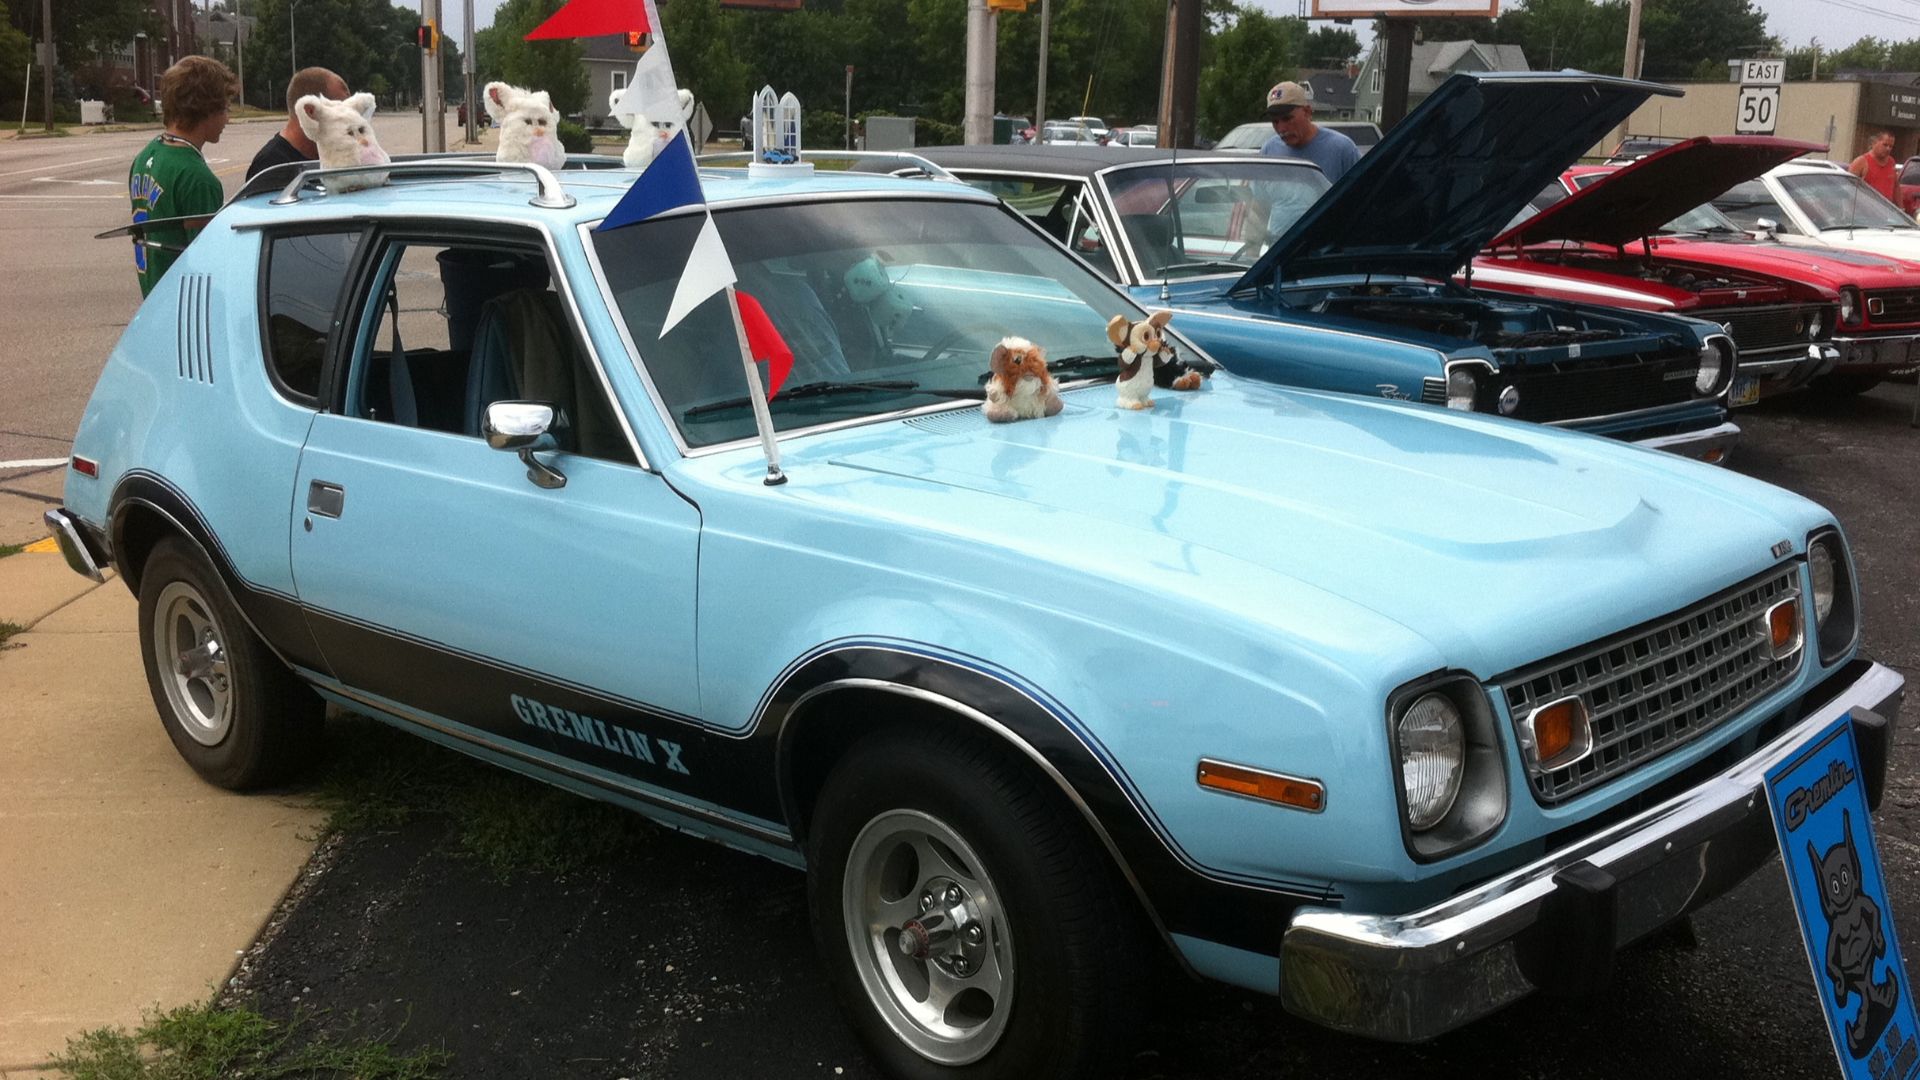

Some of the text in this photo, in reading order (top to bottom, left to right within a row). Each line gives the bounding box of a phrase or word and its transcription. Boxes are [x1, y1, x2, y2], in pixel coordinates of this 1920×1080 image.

[1747, 63, 1779, 79] EAST
[1743, 96, 1771, 124] 50
[510, 693, 690, 775] GREMLIN X
[1783, 759, 1855, 833] Gremlin
